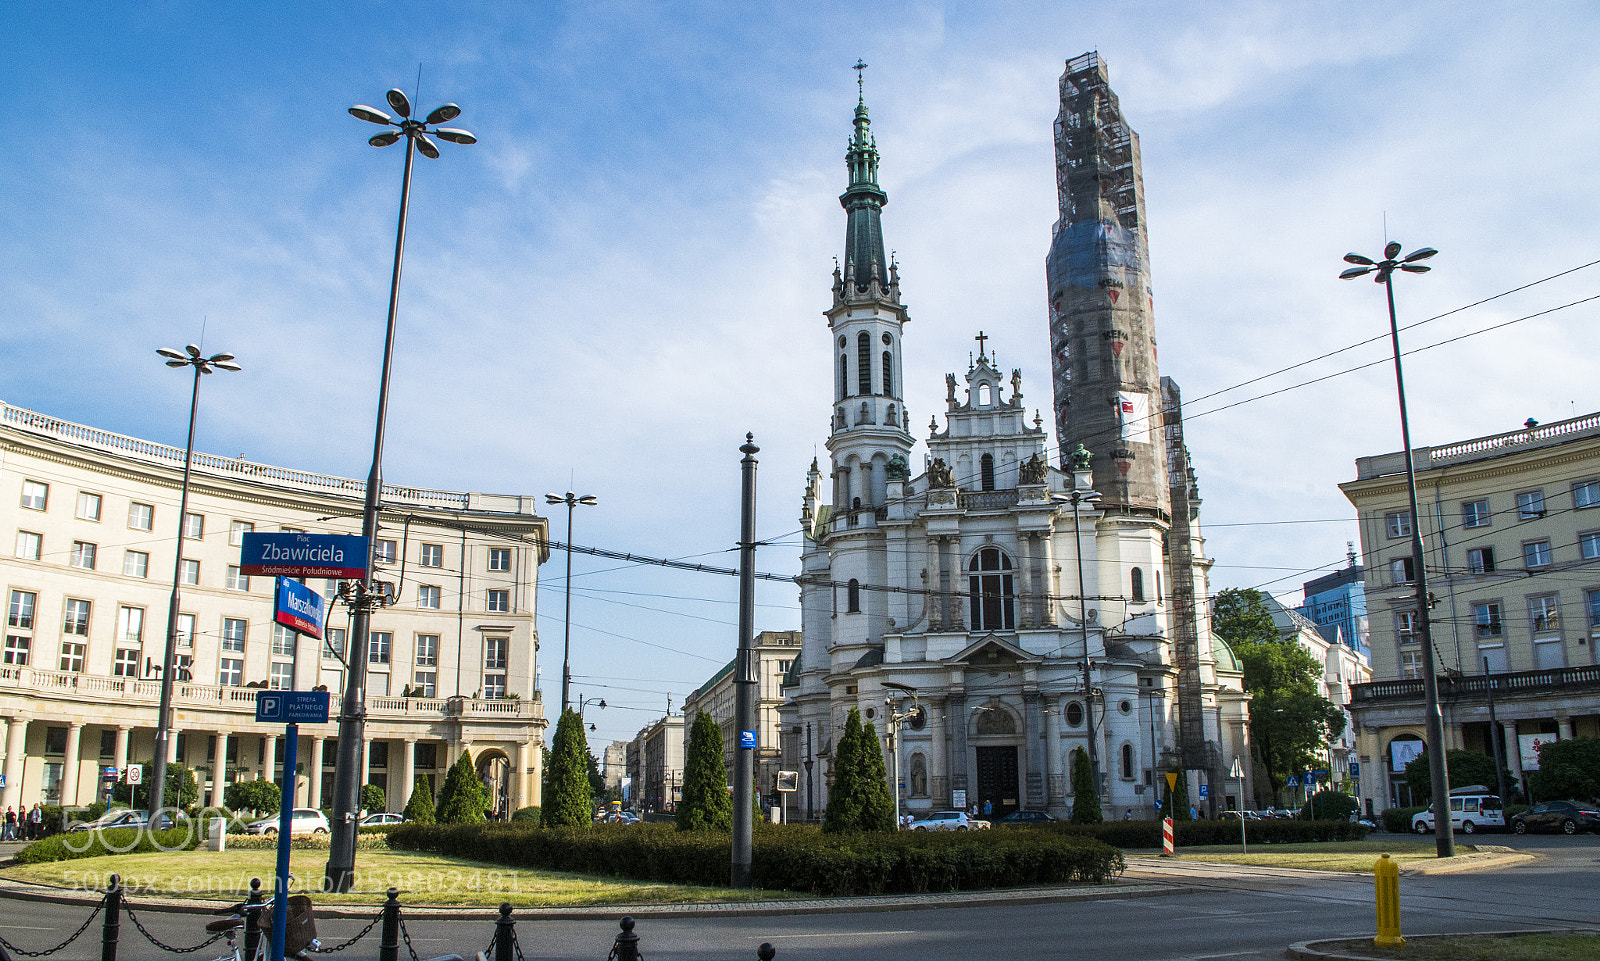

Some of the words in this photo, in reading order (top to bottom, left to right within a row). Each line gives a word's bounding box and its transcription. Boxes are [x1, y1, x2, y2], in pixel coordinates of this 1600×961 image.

[296, 534, 310, 543] Plac
[261, 543, 344, 562] Zbawiciela
[302, 567, 343, 576] Południowe
[264, 699, 276, 714] P
